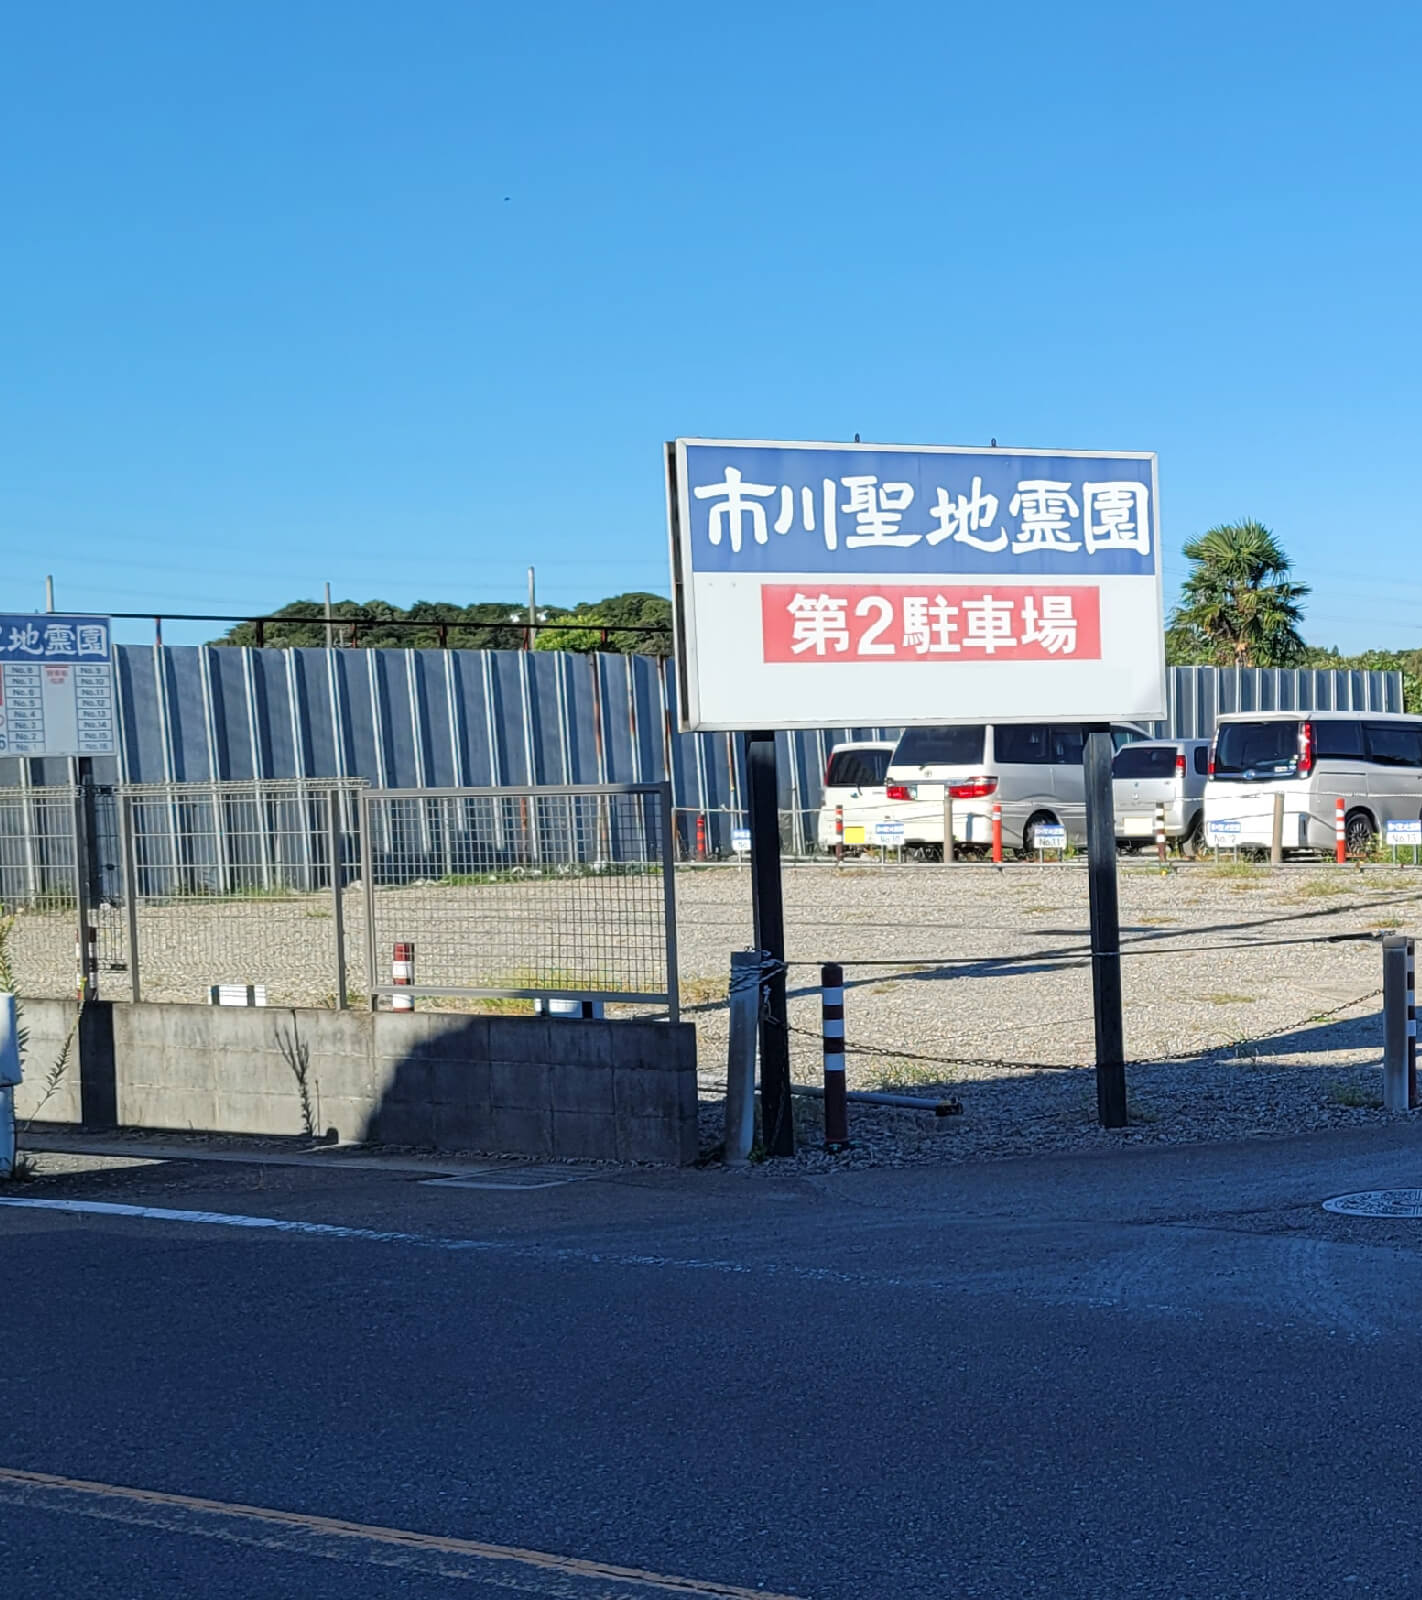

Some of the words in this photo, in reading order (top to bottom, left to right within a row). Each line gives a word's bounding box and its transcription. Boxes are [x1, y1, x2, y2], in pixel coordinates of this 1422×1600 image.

[694, 466, 1151, 556] 市川聖地霊園
[0, 622, 108, 658] 地霊園
[786, 592, 1078, 656] 第2駐車場
